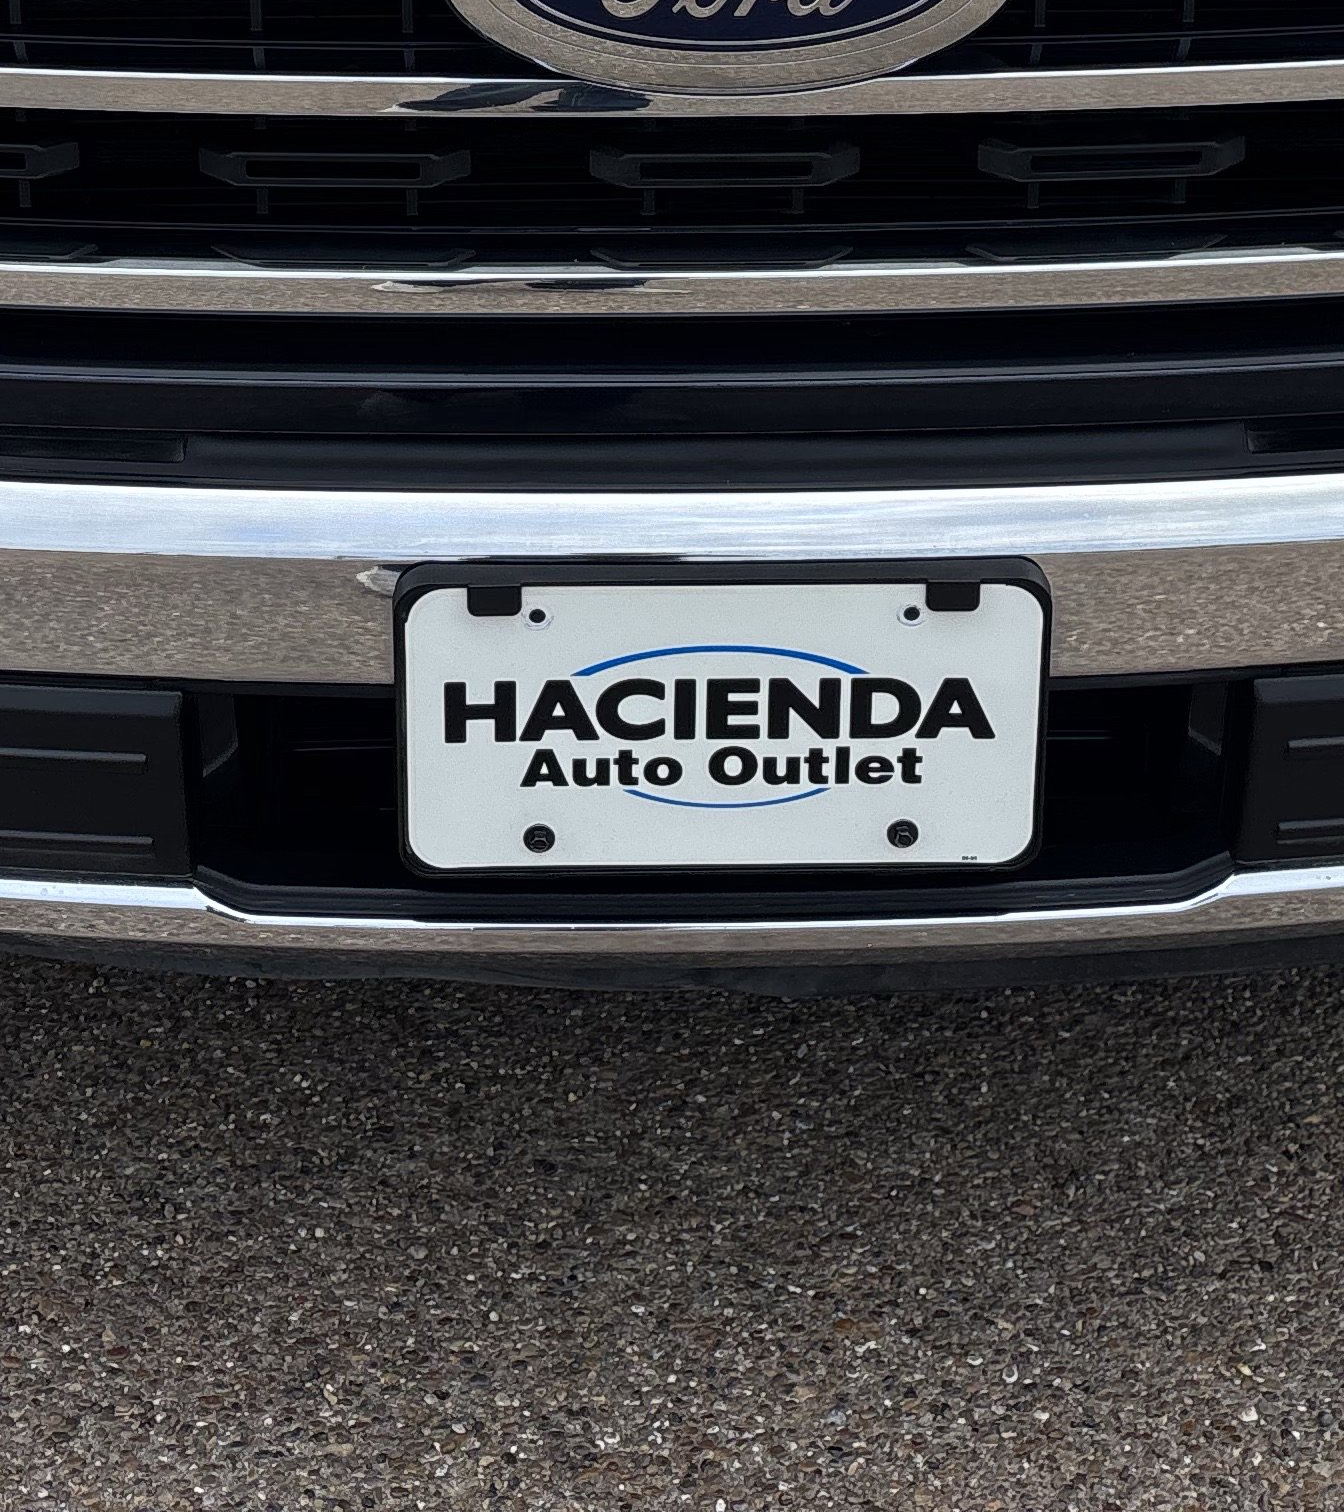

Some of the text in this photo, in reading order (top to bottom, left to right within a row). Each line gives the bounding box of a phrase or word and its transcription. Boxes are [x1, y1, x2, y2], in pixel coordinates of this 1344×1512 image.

[444, 678, 996, 743] HACIENDA
[520, 746, 923, 787] Auto Outlet
